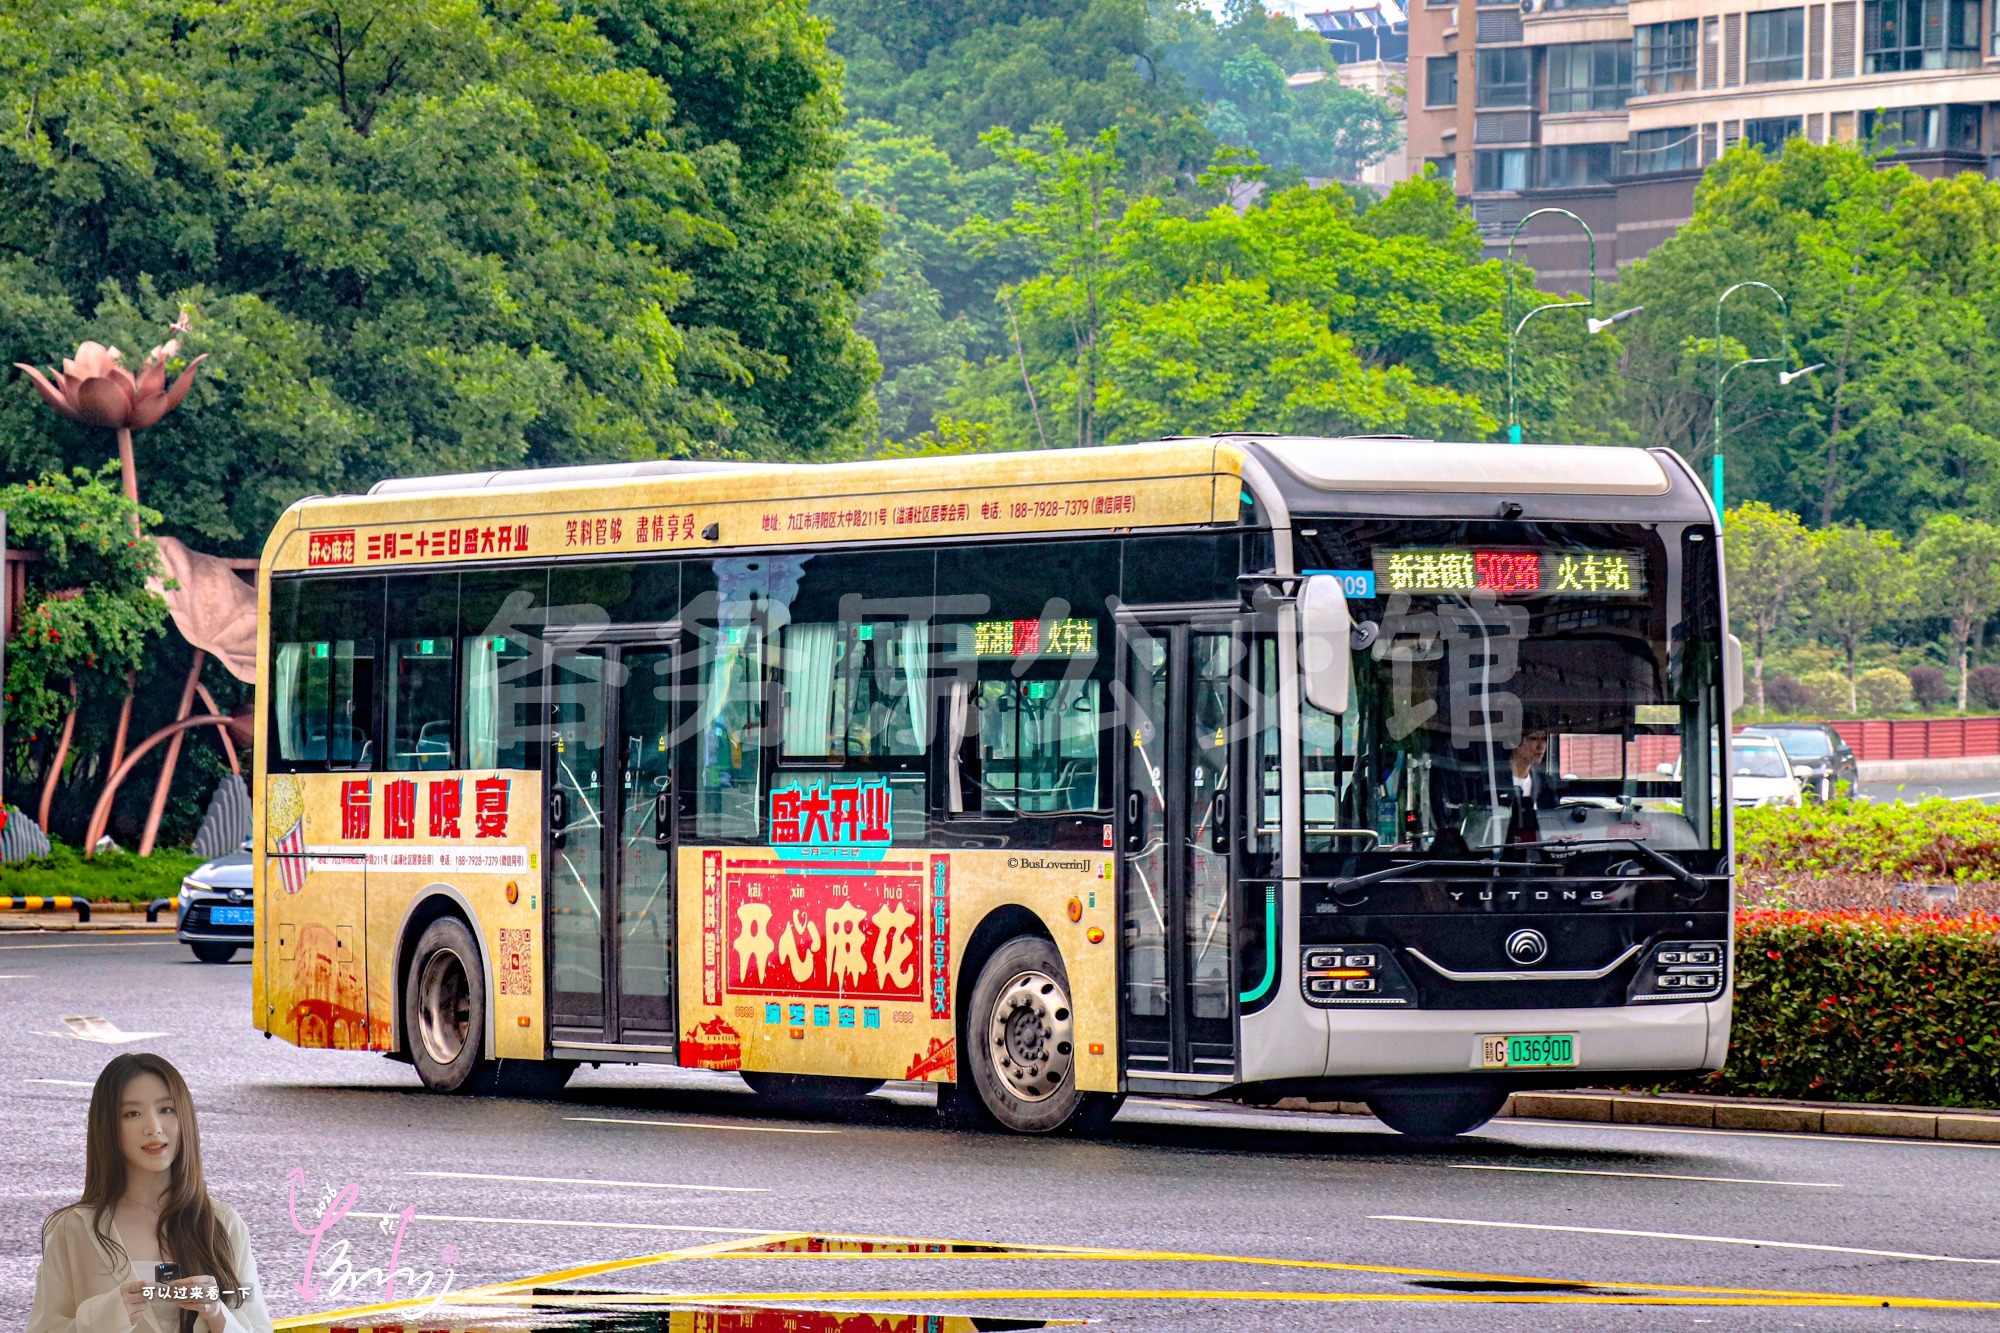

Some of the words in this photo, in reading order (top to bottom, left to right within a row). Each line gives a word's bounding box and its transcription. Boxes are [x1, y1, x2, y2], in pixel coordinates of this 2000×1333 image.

[367, 524, 529, 560] 三月二十三日盛大开业
[565, 517, 623, 547] 笑料管够
[310, 539, 354, 564] 开心麻花
[1556, 555, 1631, 592] 火车站
[1045, 618, 1094, 655] 火车站
[770, 776, 894, 844] 盛大开业
[1450, 890, 1604, 901] YUTONG
[733, 900, 916, 991] 开心麻花
[765, 1002, 880, 1029] 演艺新空间
